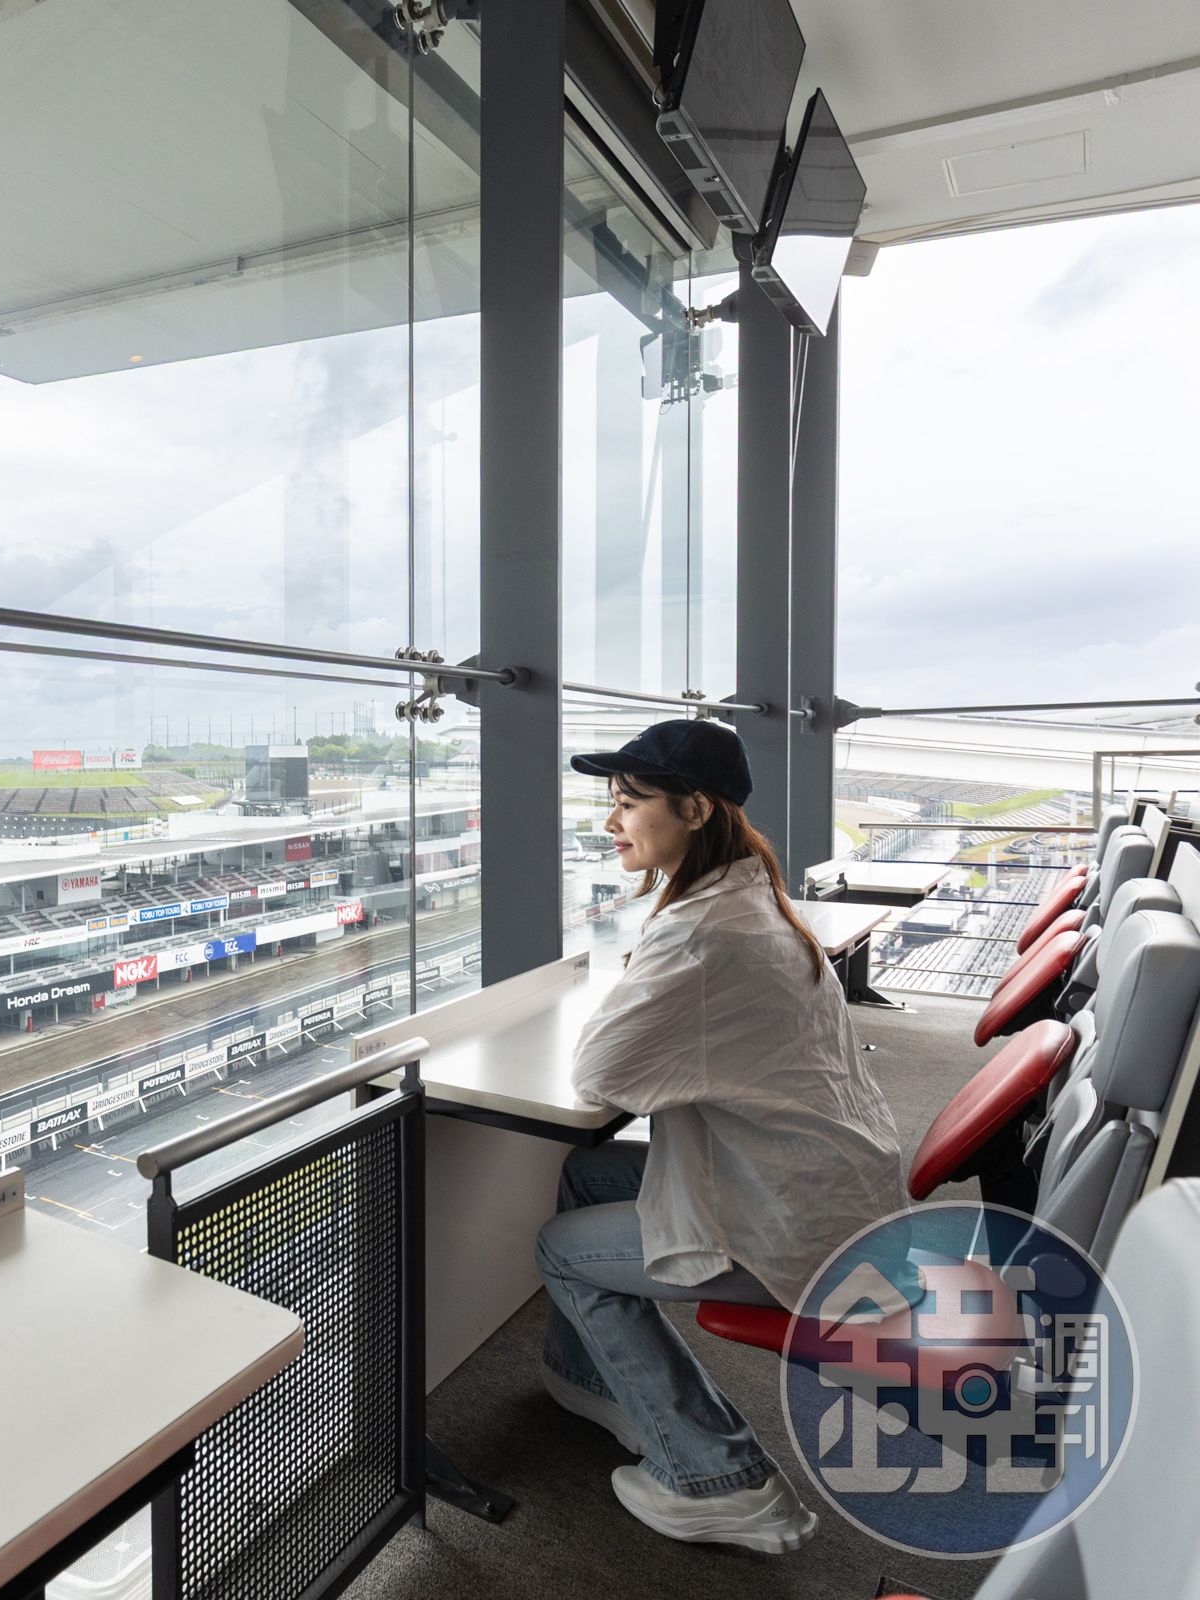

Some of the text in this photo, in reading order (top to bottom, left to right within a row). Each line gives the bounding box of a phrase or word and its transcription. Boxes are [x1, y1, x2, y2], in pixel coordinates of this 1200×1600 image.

[288, 842, 310, 850] NISSAN
[70, 875, 99, 889] YAMAHA
[338, 905, 357, 922] NGK
[116, 961, 148, 984] NGK
[7, 991, 49, 1009] Honda
[51, 982, 90, 999] Dream
[303, 1011, 331, 1026] POTENZA
[189, 1053, 225, 1073] BRIDGESTONE
[142, 1070, 182, 1090] POTENZA
[92, 1088, 135, 1111] BRIDGESTONE
[37, 1108, 82, 1133] BATTLAX
